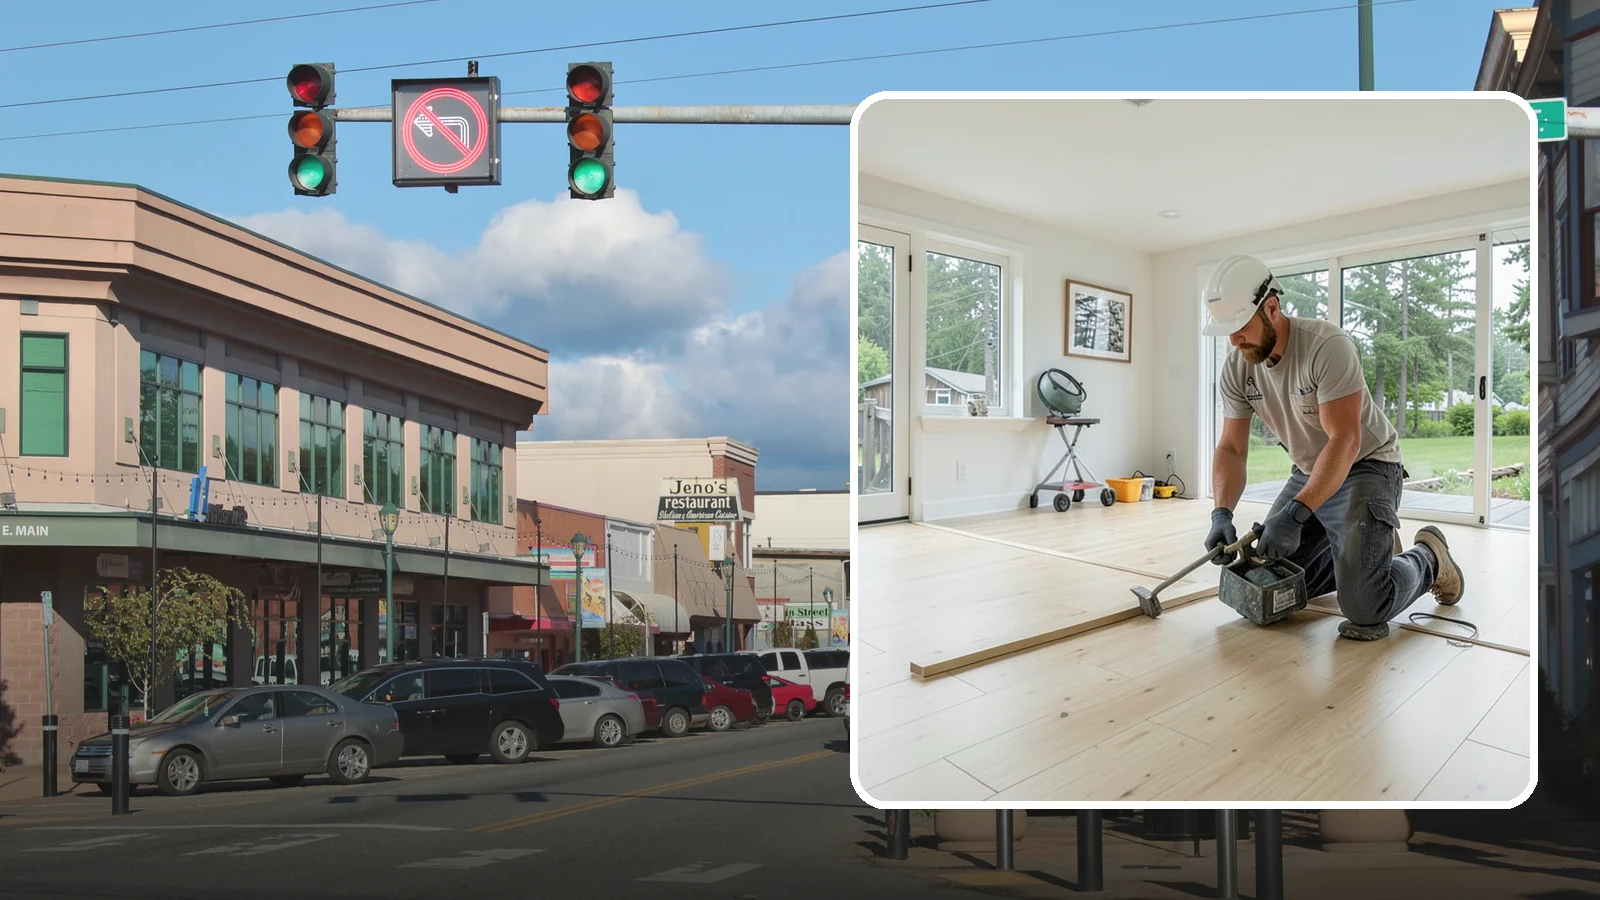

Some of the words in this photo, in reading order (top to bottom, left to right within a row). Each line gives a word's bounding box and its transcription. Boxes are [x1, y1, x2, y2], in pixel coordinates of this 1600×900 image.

[669, 480, 728, 495] Jeno's
[665, 496, 731, 509] restaurant
[658, 509, 681, 520] Italian
[685, 509, 714, 519] American
[714, 509, 737, 519] Cuisine
[2, 525, 13, 536] E.
[15, 525, 49, 536] MAIN
[785, 607, 795, 617] in
[797, 607, 828, 617] Street
